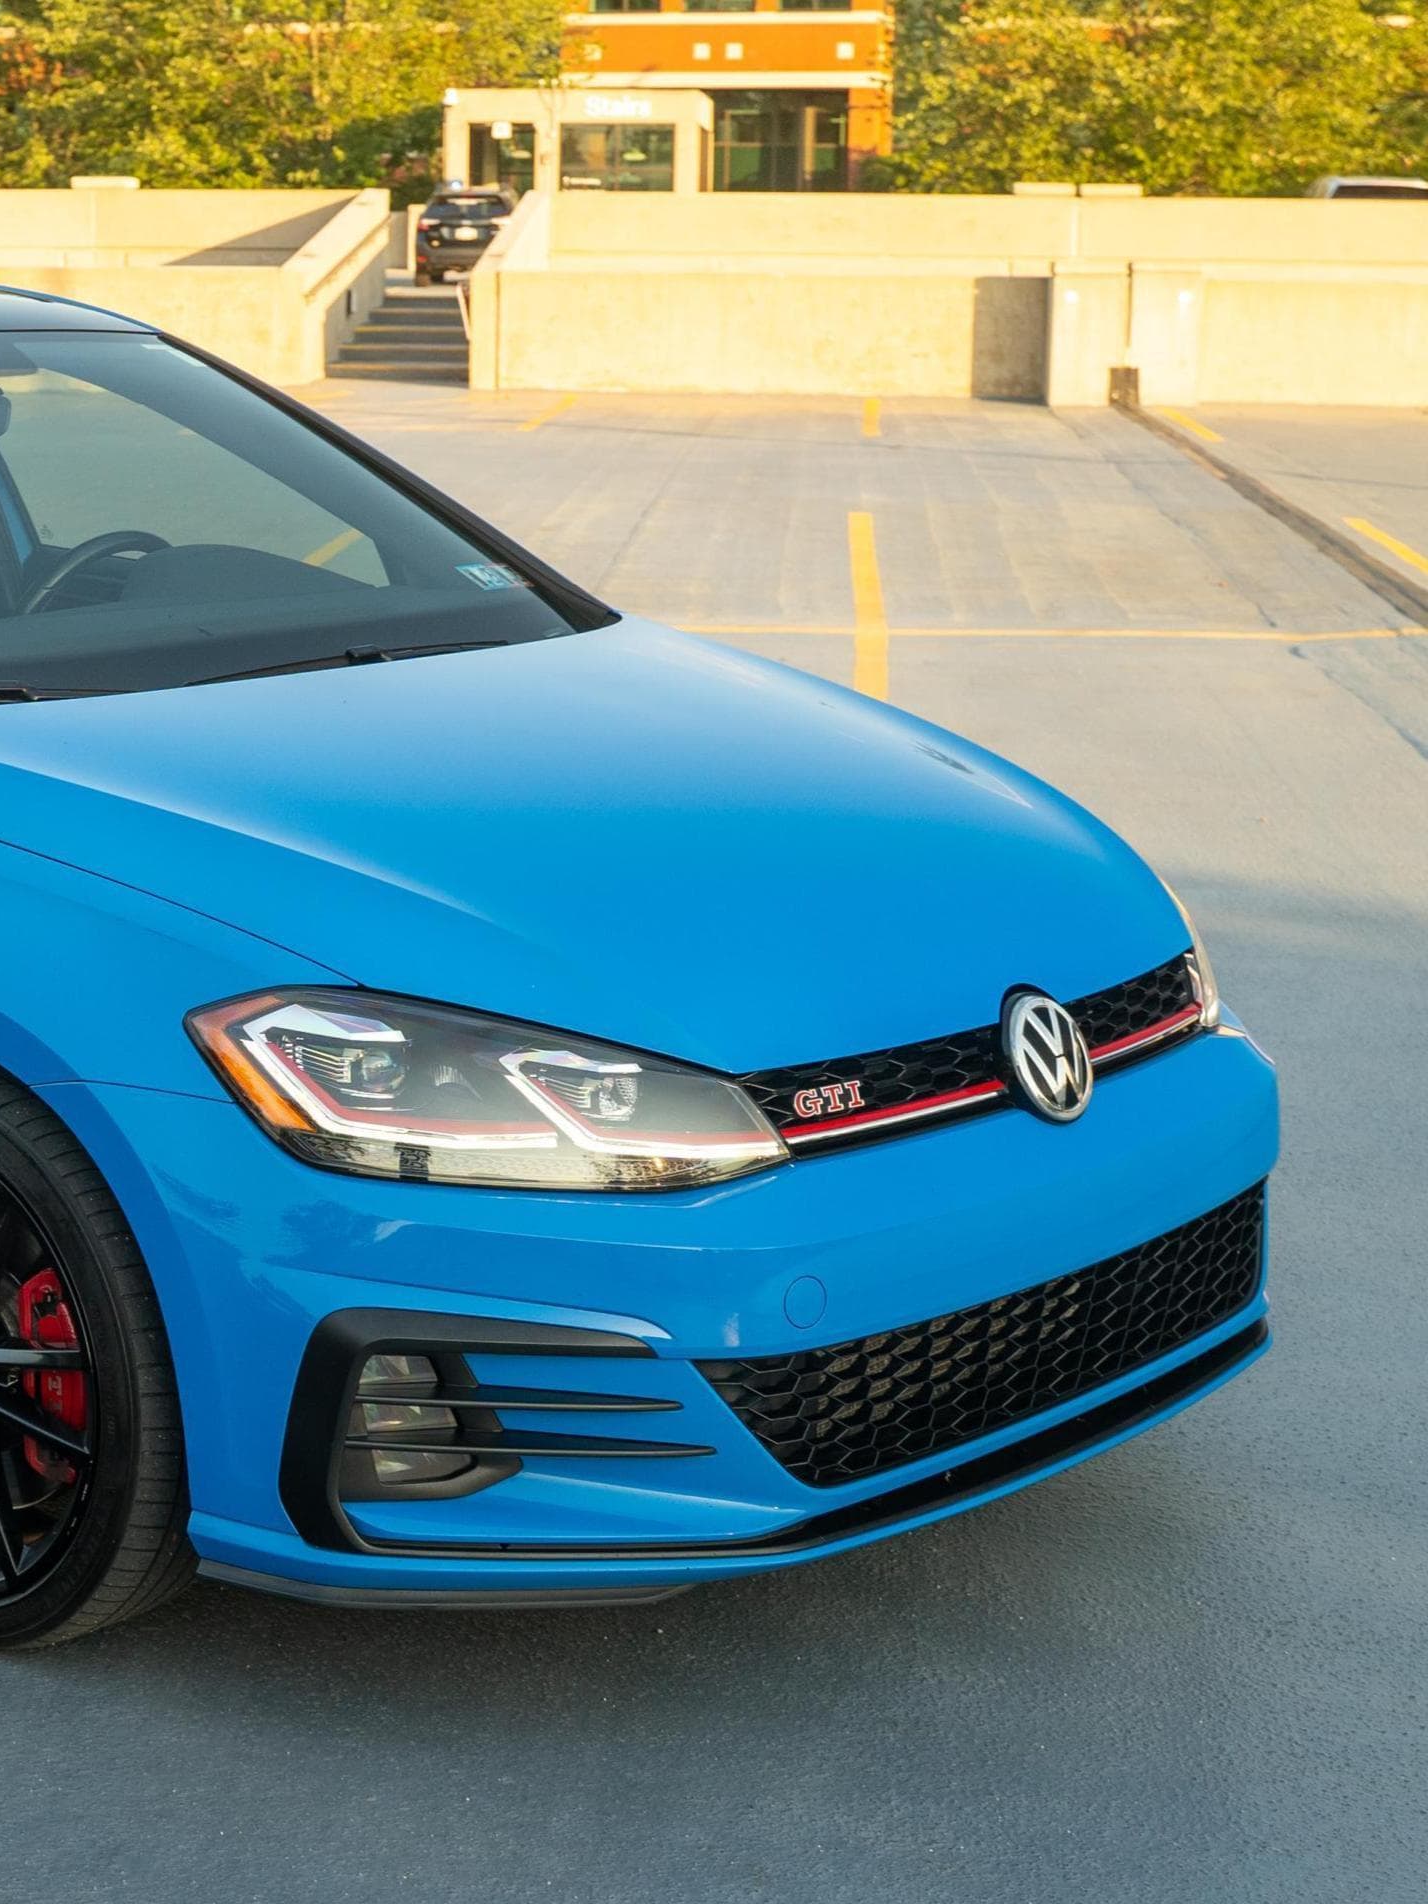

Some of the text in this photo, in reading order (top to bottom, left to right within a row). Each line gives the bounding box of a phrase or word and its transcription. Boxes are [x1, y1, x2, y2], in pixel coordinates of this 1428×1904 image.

[584, 95, 650, 117] Stairs
[1016, 1000, 1088, 1113] VW
[794, 1080, 865, 1117] GTI
